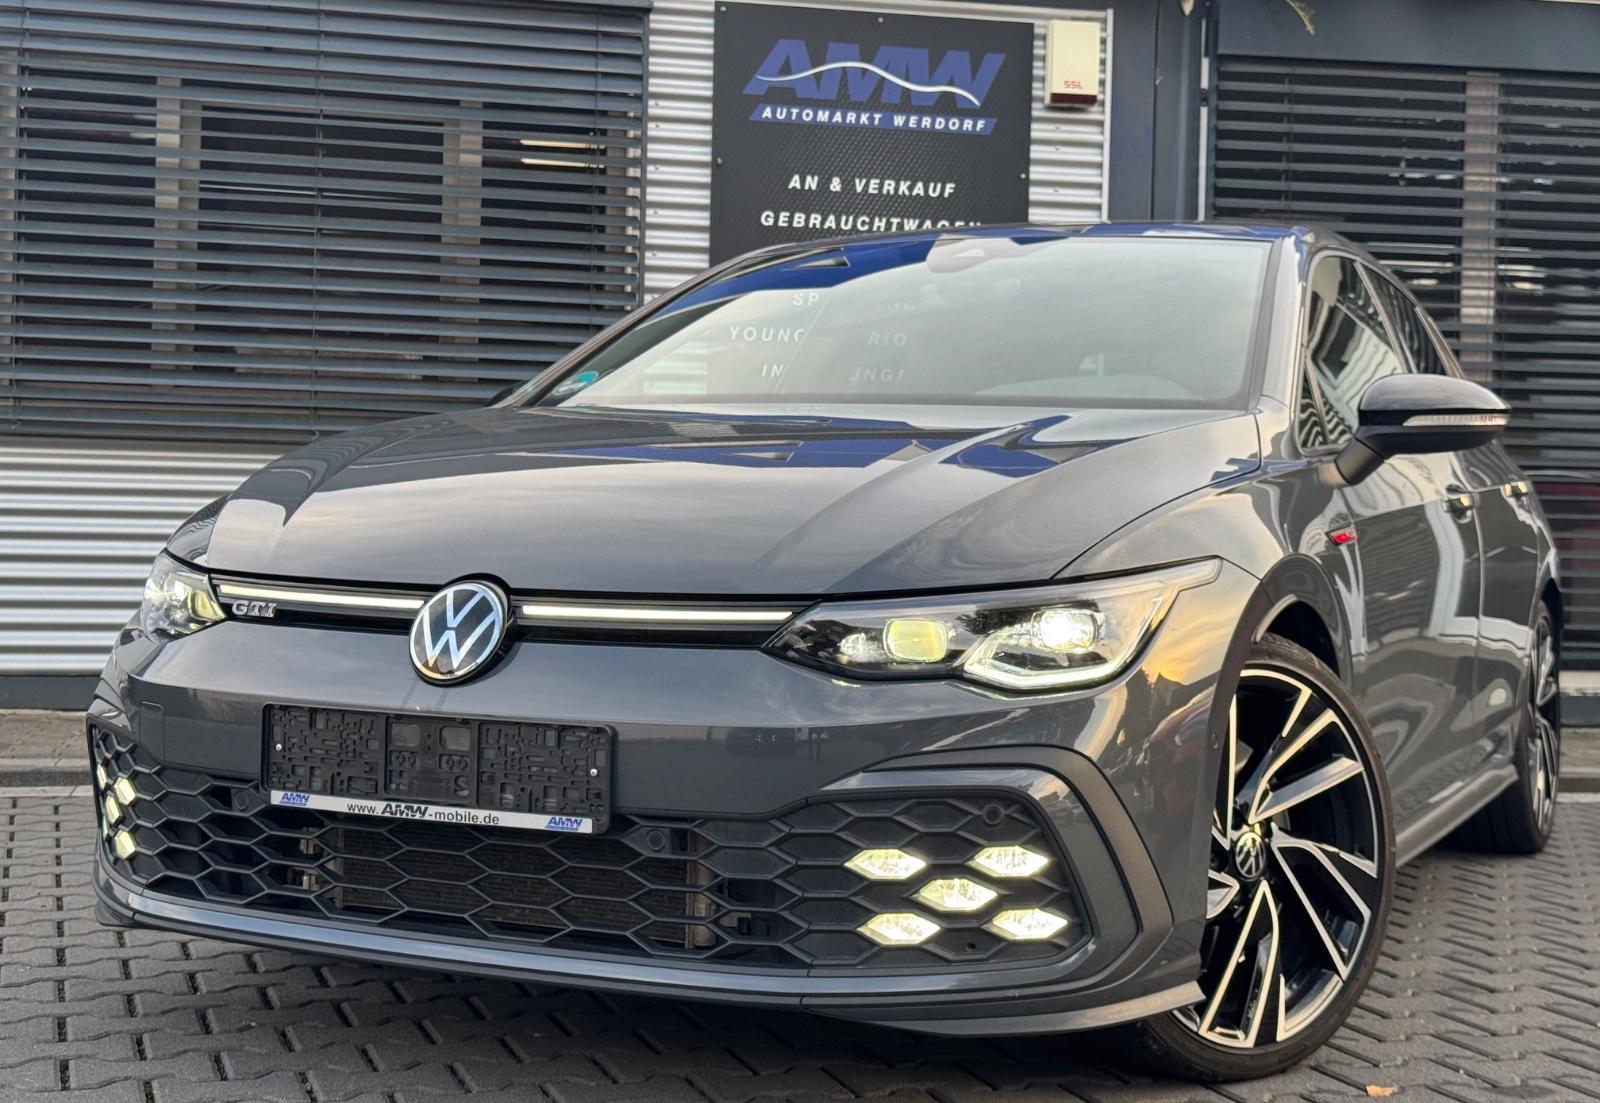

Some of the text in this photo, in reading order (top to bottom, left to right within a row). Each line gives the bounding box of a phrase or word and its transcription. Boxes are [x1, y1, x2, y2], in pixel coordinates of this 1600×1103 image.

[742, 39, 1006, 108] AMW
[762, 107, 988, 132] AUTOMARKT WERDORF
[788, 174, 956, 198] AN & VERKAUF
[760, 211, 982, 232] GEBRAUCHTWA
[231, 600, 277, 618] GTI
